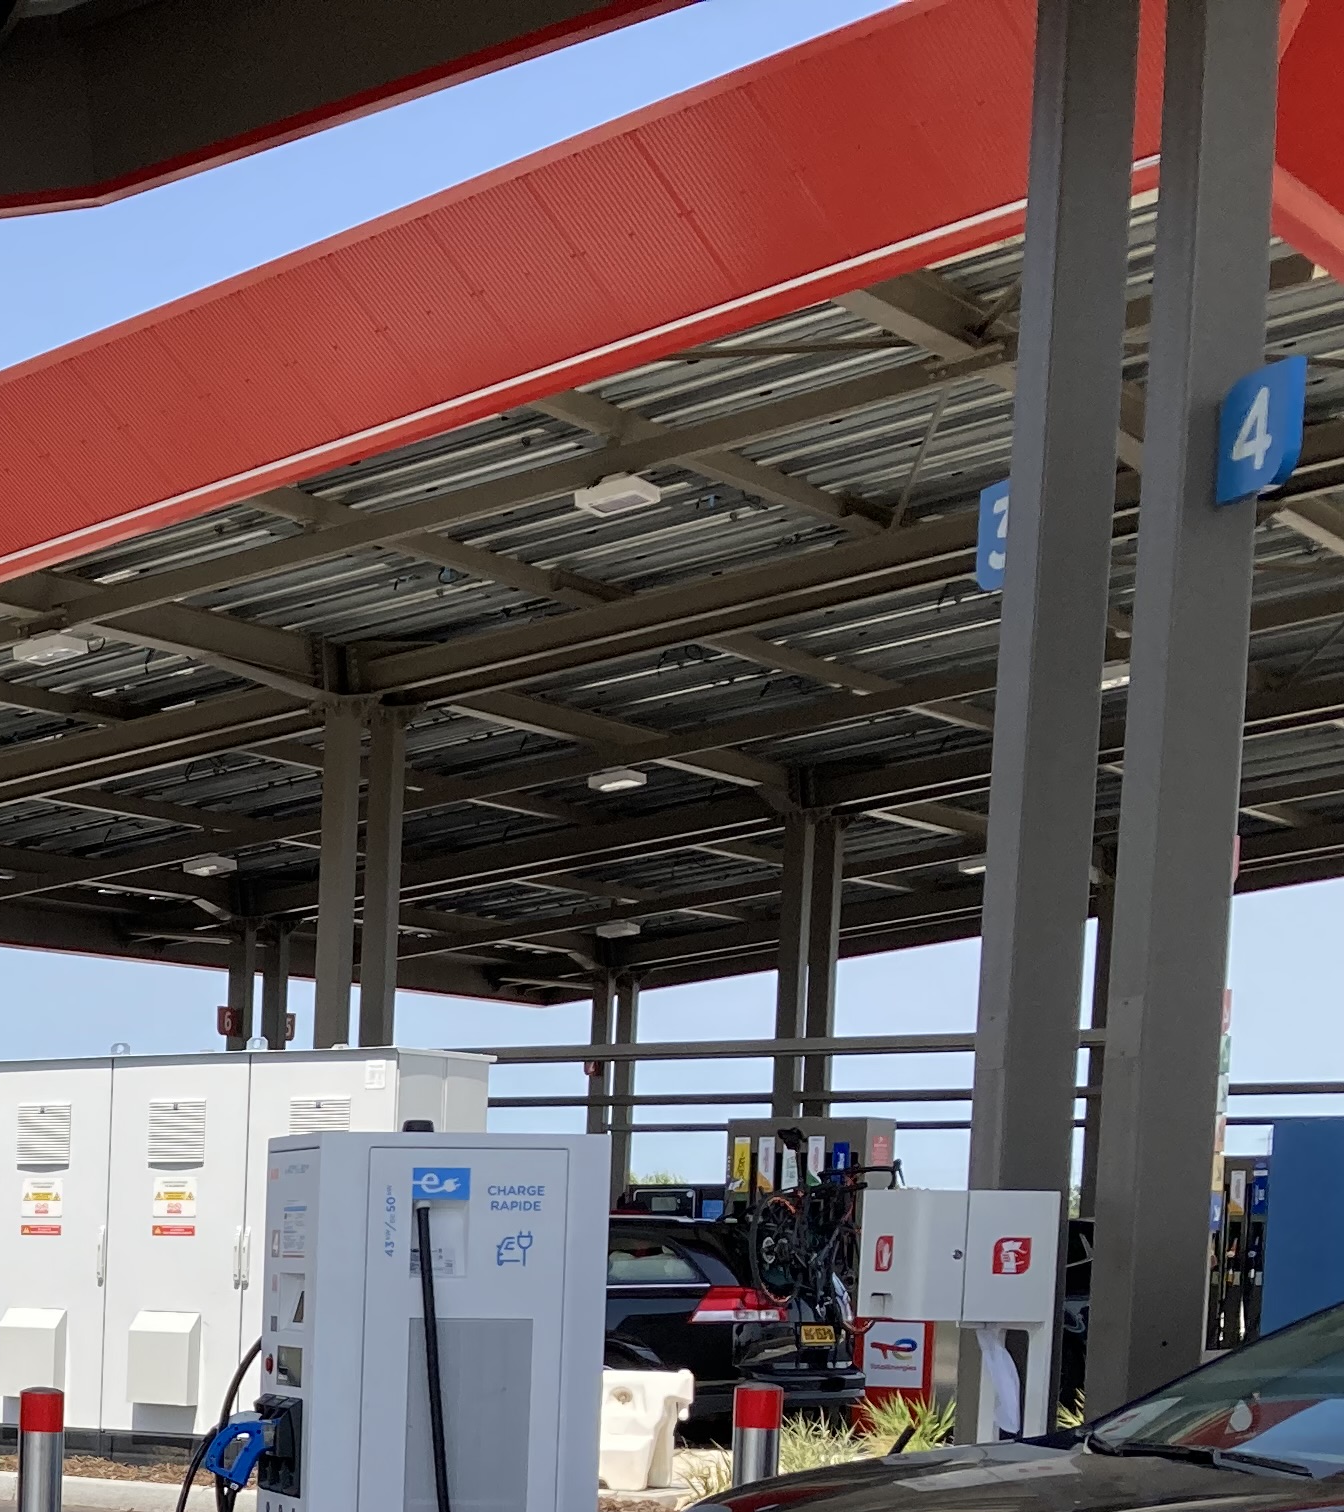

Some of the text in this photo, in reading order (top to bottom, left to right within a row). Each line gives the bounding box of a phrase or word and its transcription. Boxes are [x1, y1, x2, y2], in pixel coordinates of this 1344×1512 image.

[1231, 386, 1273, 471] 4
[224, 1011, 232, 1032] 6
[285, 1017, 292, 1039] 5
[487, 1185, 546, 1197] CHARGE
[490, 1200, 542, 1212] RAPIDE
